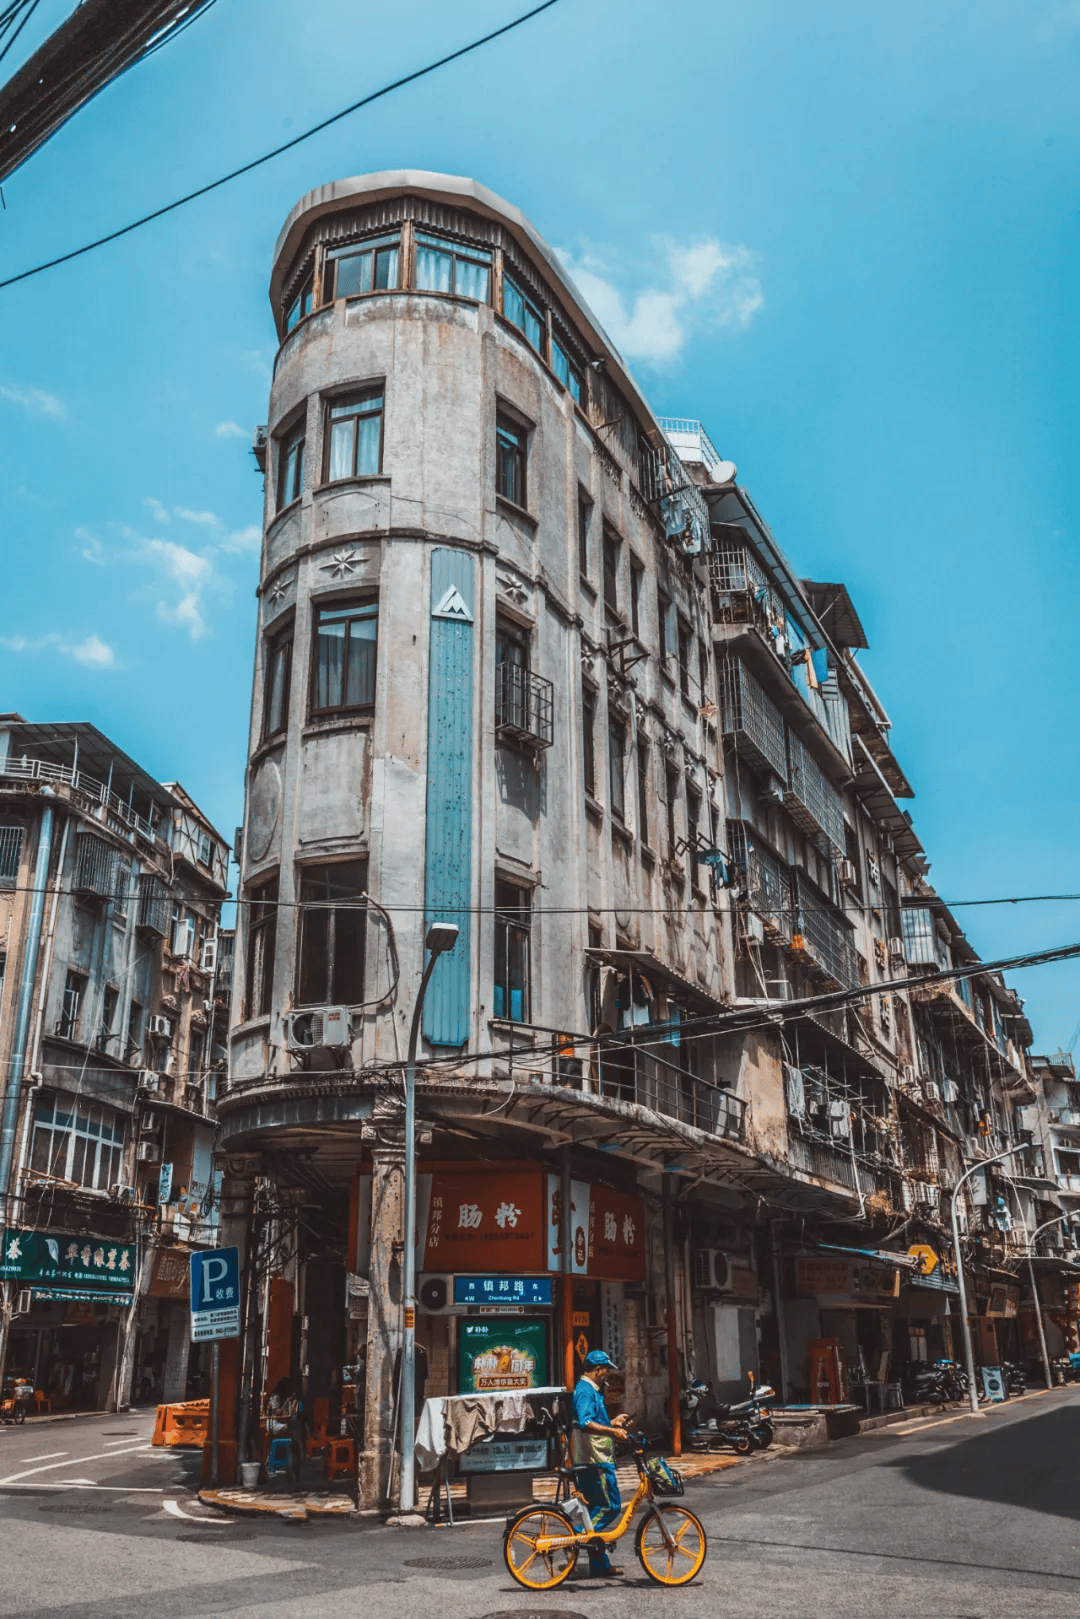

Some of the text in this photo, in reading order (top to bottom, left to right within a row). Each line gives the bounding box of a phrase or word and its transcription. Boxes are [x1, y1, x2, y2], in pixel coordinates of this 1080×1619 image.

[428, 1196, 443, 1248] 镇邦分店
[457, 1201, 522, 1229] 肠粉
[604, 1211, 636, 1245] 肠粉
[5, 1238, 23, 1260] 茶
[202, 1258, 228, 1302] P
[215, 1286, 234, 1300] 收费
[468, 1282, 475, 1290] 西
[483, 1280, 524, 1291] 镇邦路
